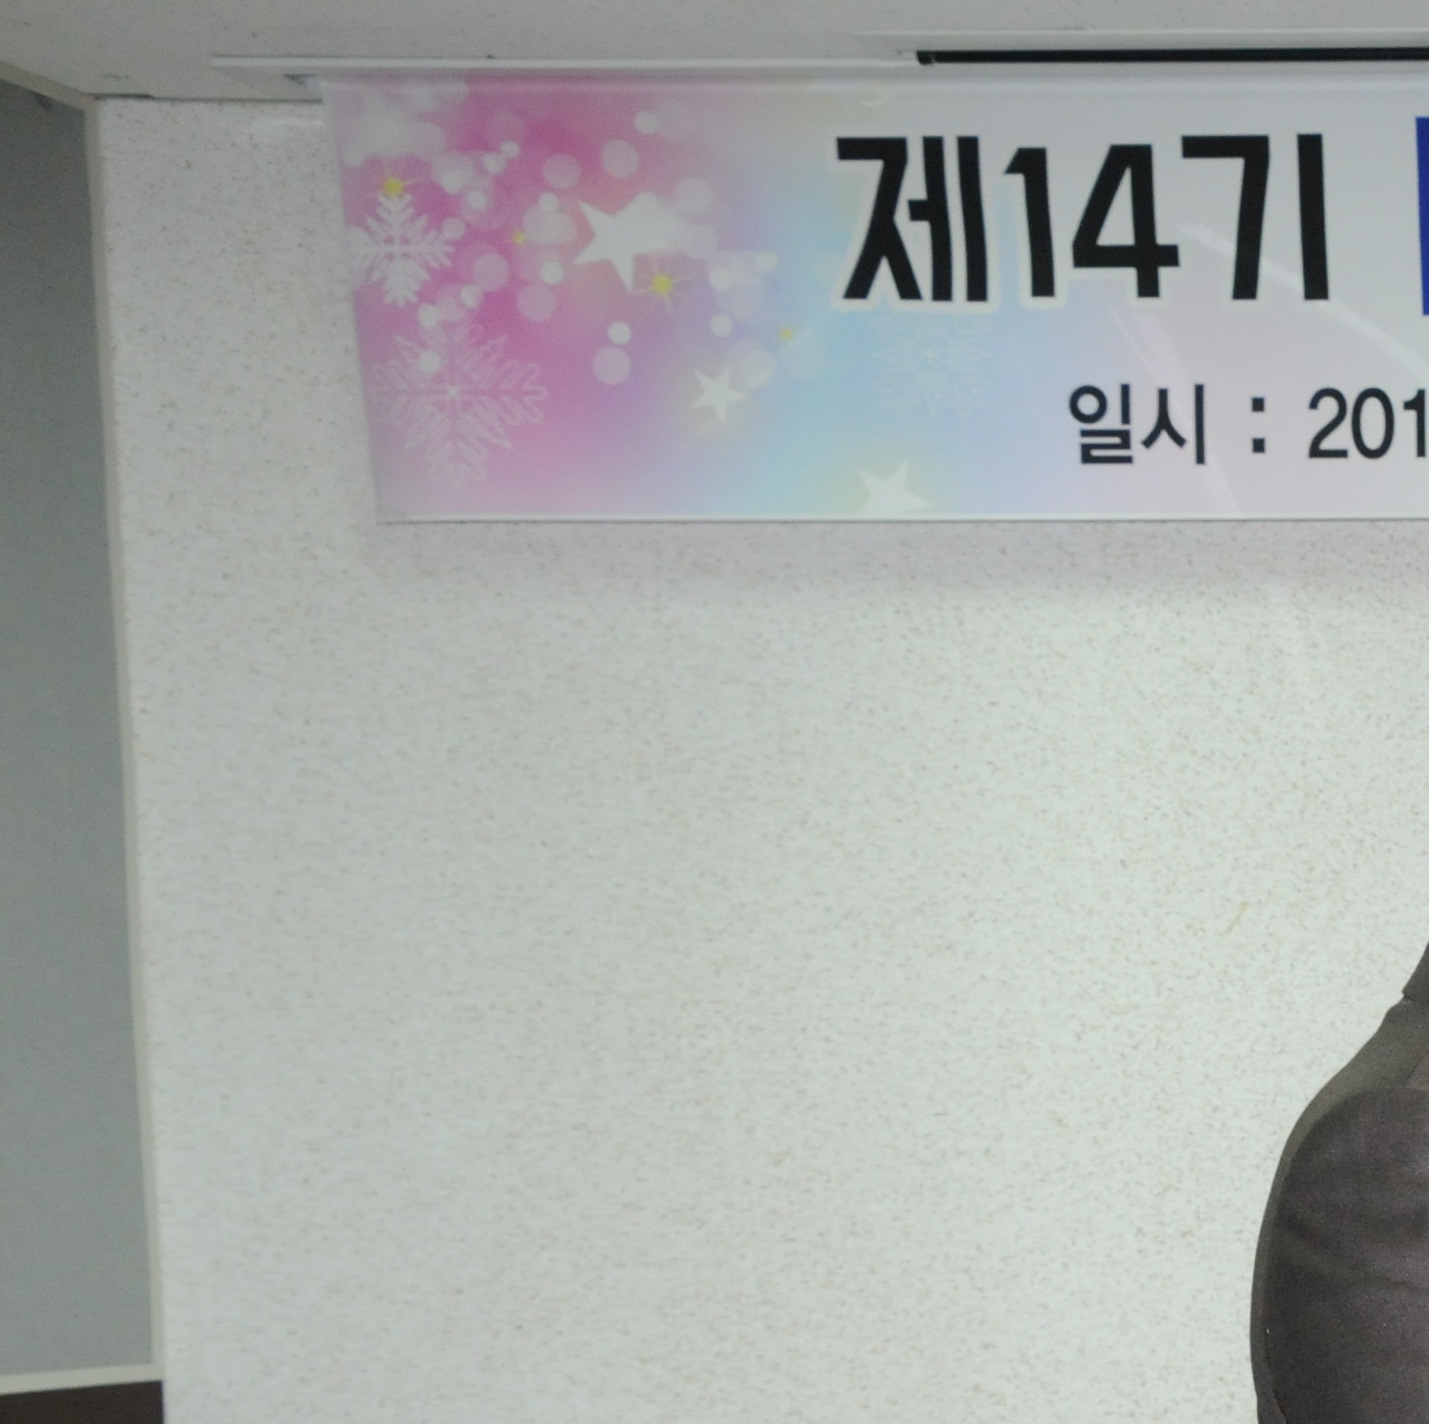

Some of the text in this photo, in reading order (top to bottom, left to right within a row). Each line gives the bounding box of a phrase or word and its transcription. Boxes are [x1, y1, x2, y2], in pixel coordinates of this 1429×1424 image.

[836, 133, 1329, 303] 제14기
[1068, 384, 1205, 465] 일시
[1251, 397, 1266, 454] :
